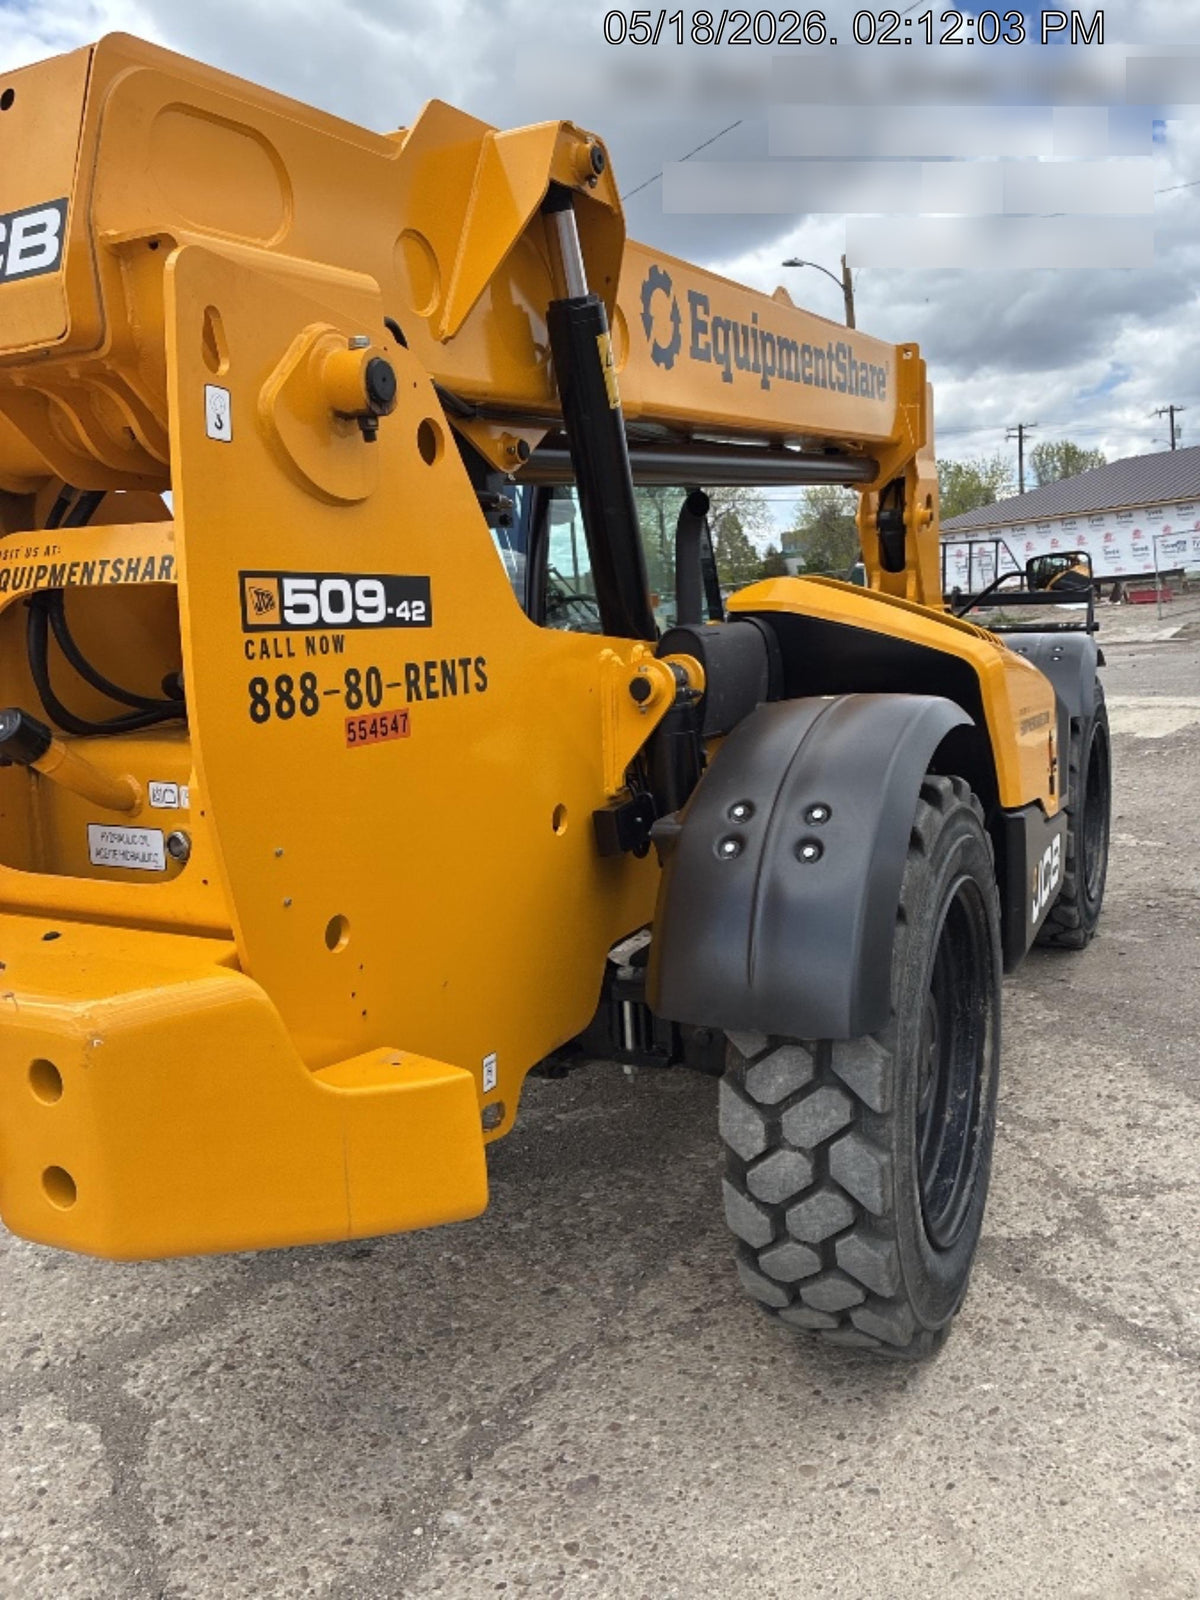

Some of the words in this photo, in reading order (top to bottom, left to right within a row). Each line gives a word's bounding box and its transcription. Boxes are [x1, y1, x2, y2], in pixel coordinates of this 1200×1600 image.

[0, 207, 61, 276] B
[687, 289, 887, 401] EquipmentShare
[0, 554, 178, 592] QUIPMENTSHAR
[24, 546, 39, 559] US
[43, 544, 61, 557] AT:
[244, 637, 296, 660] CALL
[305, 634, 346, 657] NOW
[248, 656, 488, 724] 888-80-RENTS
[347, 713, 409, 743] 554547
[1032, 833, 1061, 924] JCB
